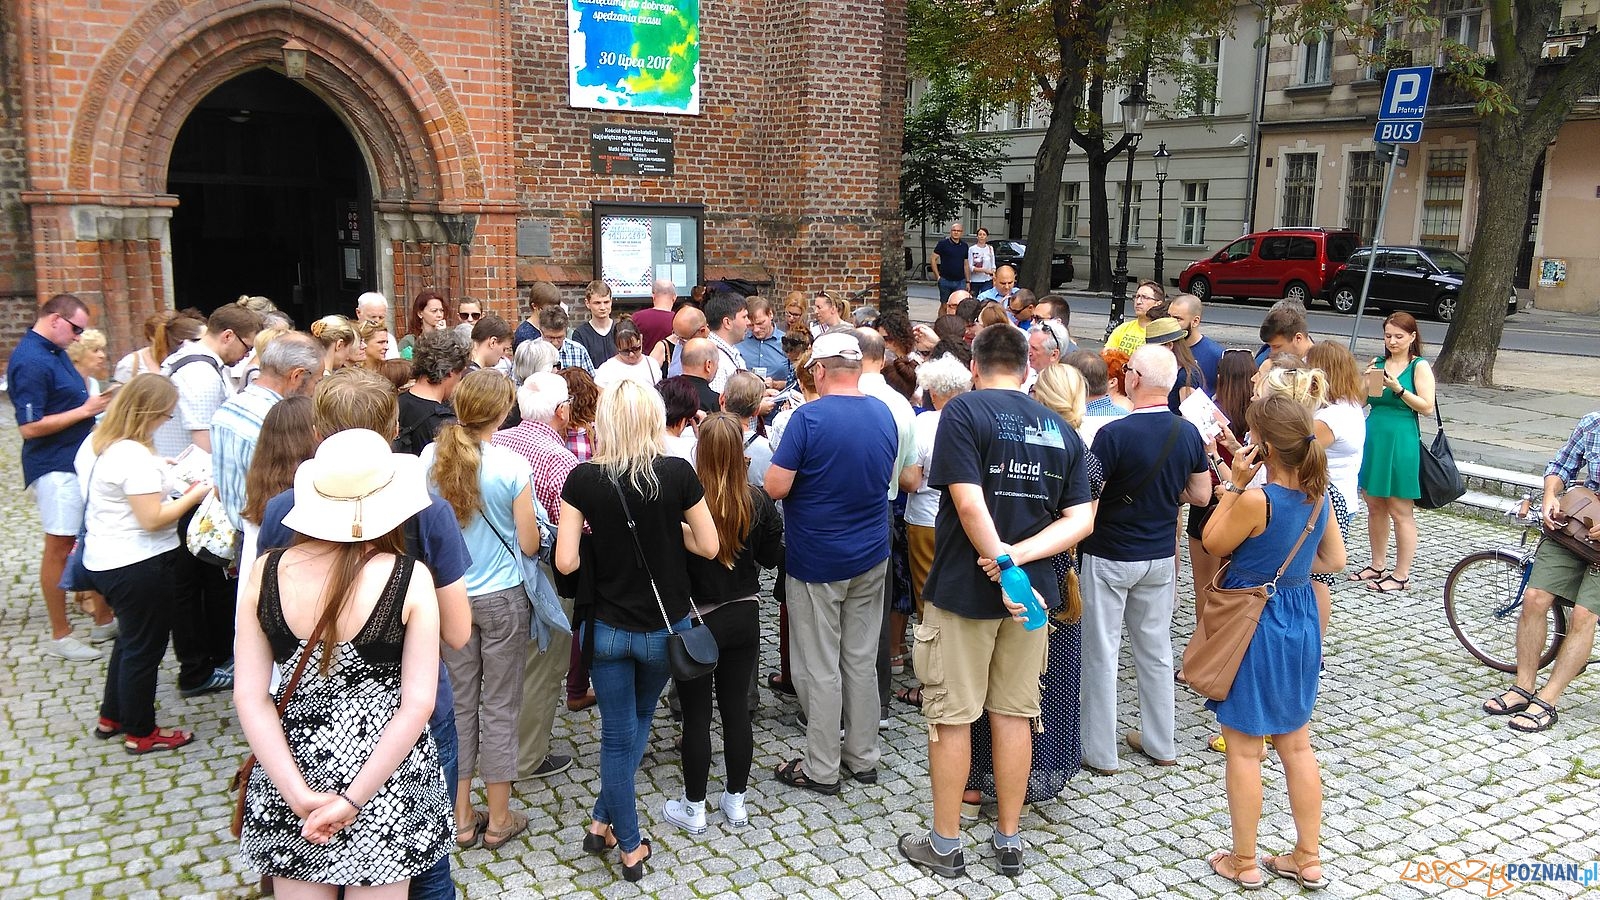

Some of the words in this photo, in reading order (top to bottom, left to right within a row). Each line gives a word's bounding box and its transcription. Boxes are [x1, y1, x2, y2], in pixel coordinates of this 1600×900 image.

[593, 11, 637, 23] spędzania
[638, 15, 661, 25] czasu
[599, 51, 616, 66] 30
[618, 53, 645, 70] lipca
[647, 55, 673, 70] 2017
[1389, 73, 1421, 114] P
[1381, 124, 1415, 140] BUS
[1008, 458, 1041, 476] lucid
